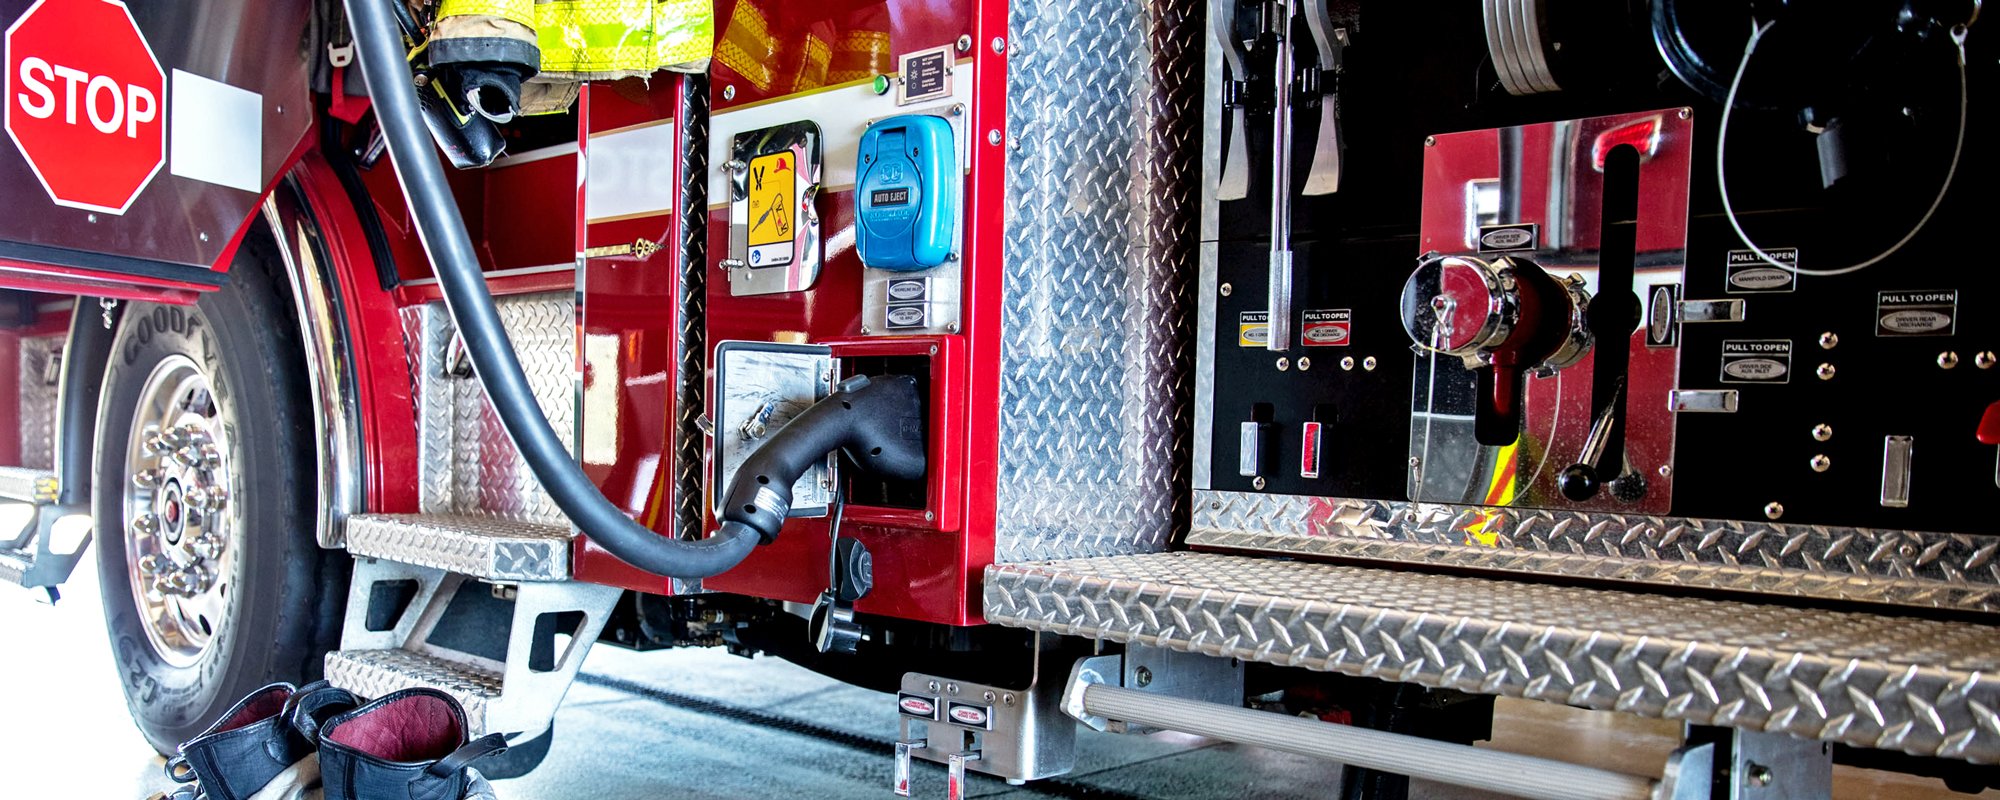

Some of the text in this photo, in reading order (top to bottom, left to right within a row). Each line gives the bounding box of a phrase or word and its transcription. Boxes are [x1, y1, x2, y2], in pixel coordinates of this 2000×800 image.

[18, 56, 157, 138] STOP
[874, 191, 907, 203] AUTO EJECT
[1731, 254, 1755, 262] PULL
[1770, 252, 1795, 260] OPEN
[1882, 293, 1954, 303] PULL TO OPEN
